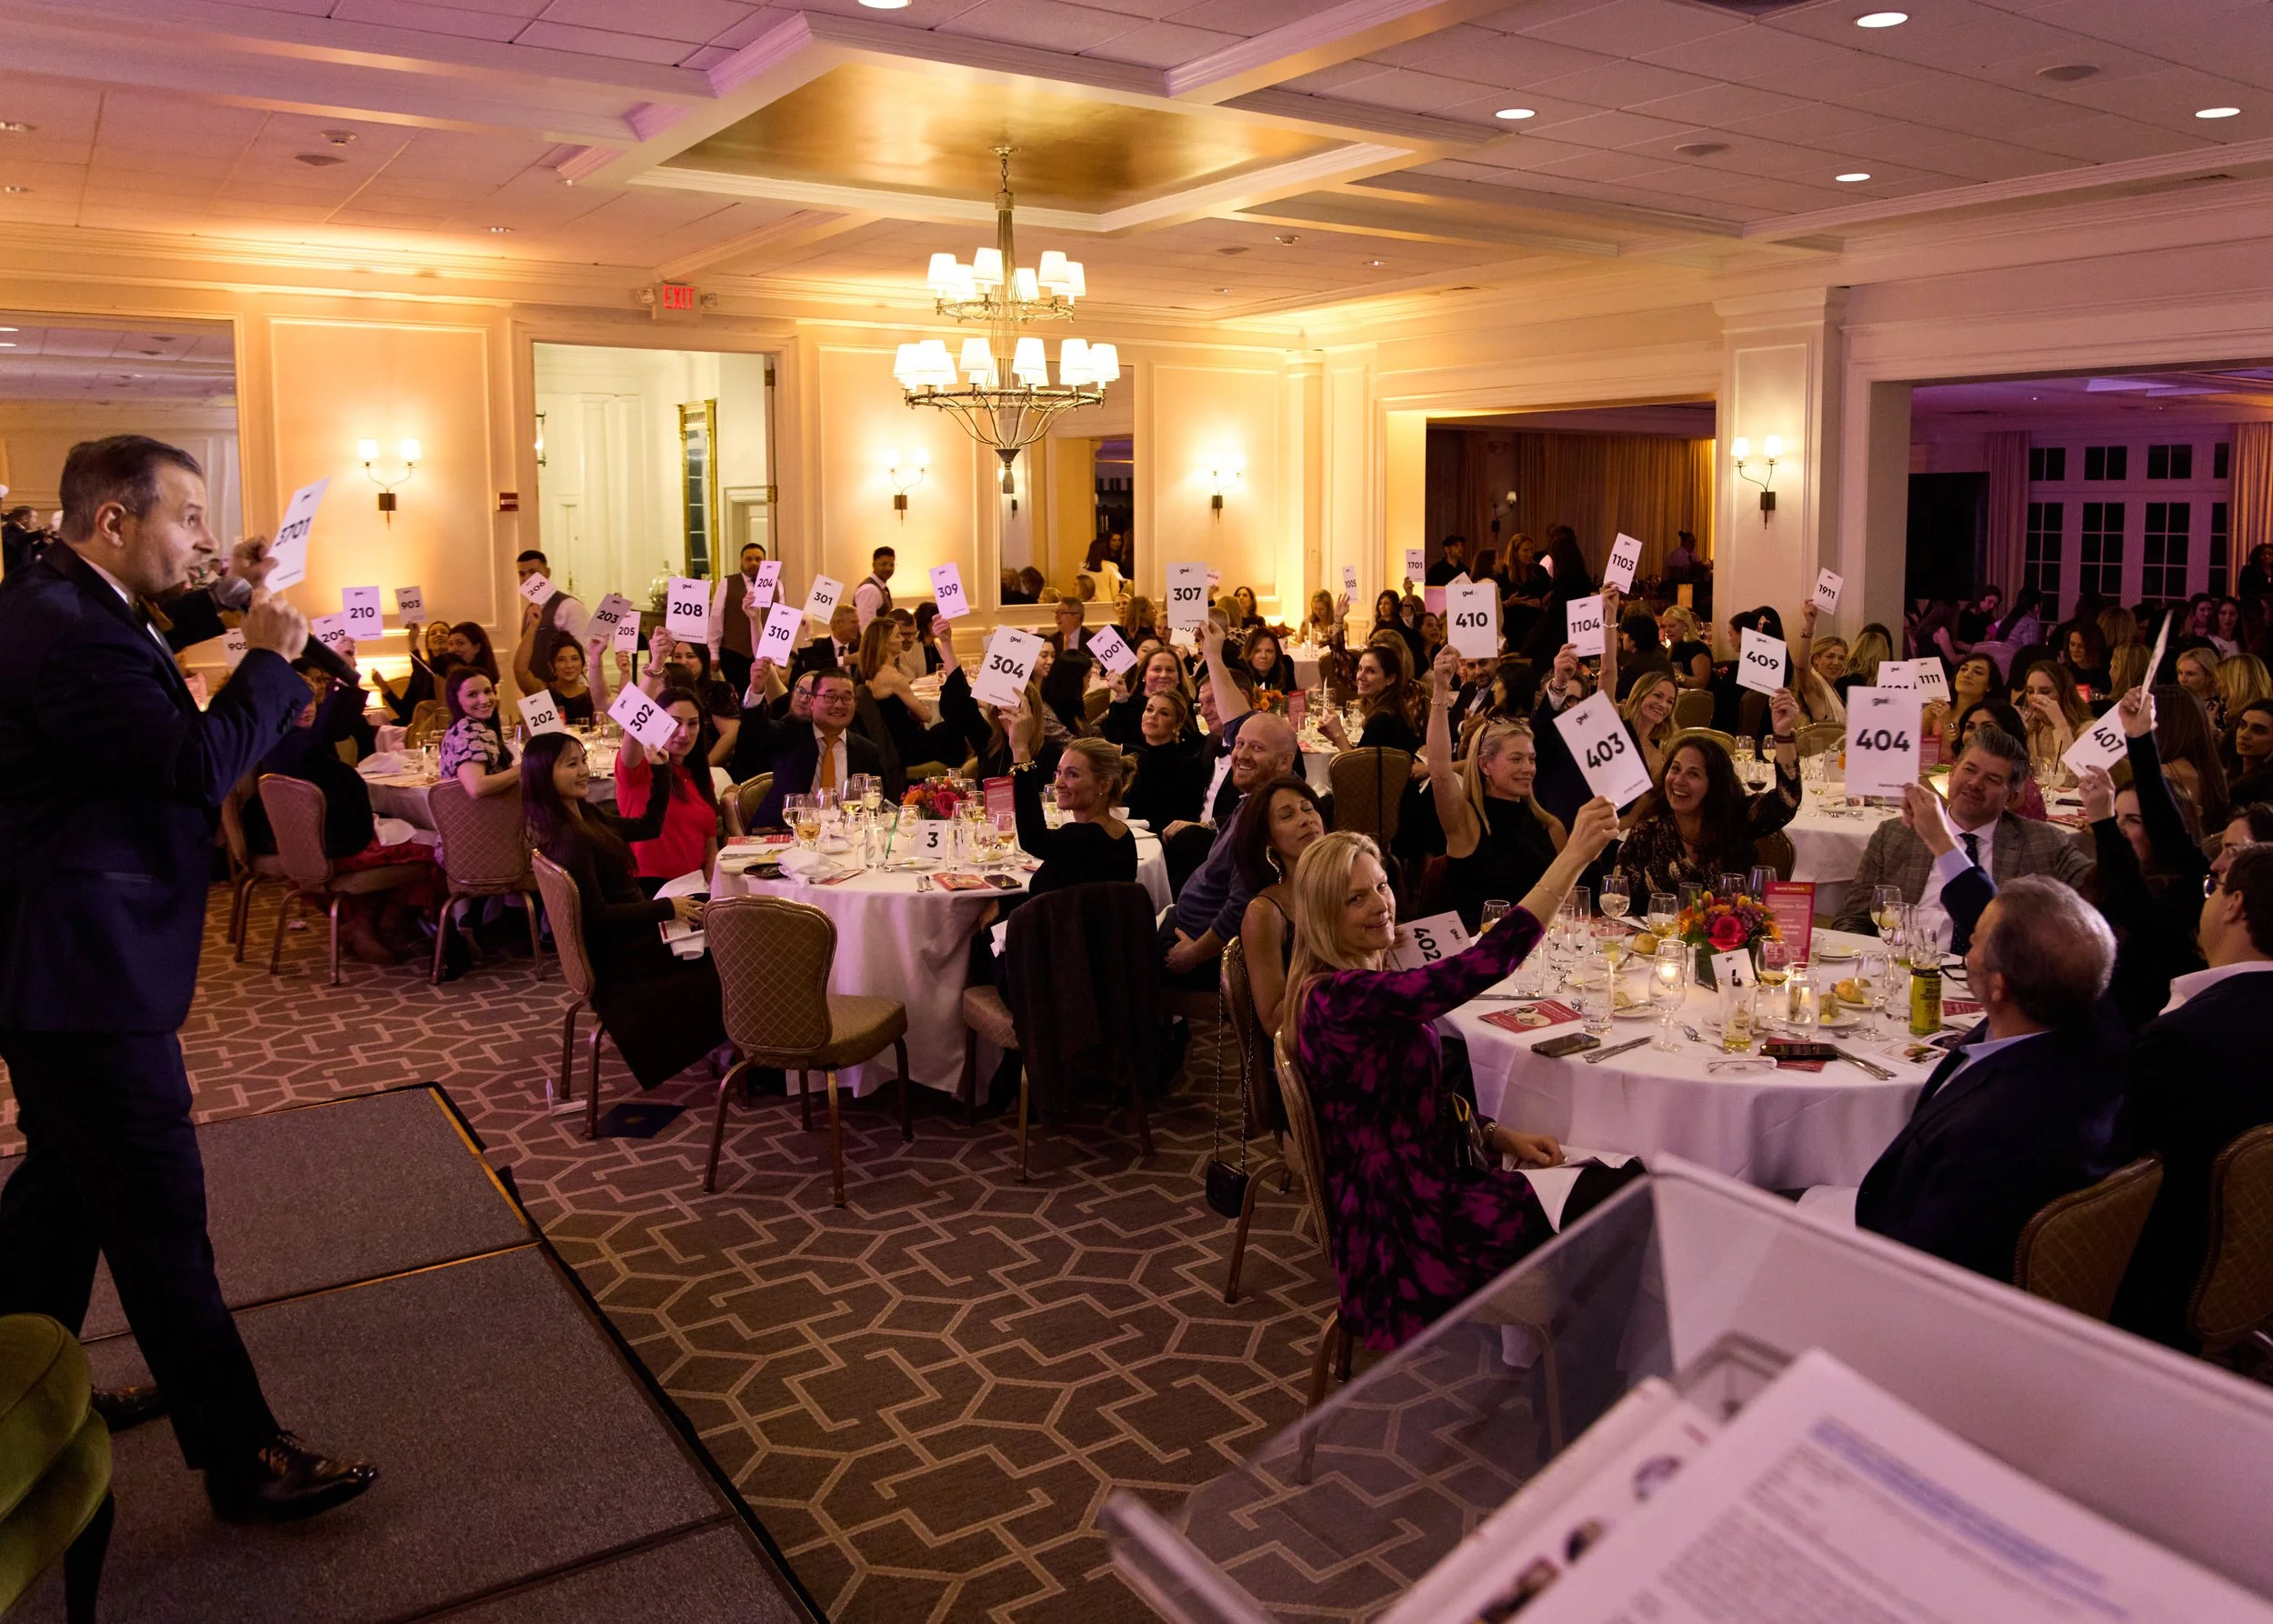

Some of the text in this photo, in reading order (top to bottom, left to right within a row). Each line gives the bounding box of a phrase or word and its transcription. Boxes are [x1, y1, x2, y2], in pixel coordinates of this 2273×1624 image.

[663, 285, 696, 310] EXIT
[1407, 561, 1423, 569] 1701
[1612, 554, 1635, 572] 1103
[527, 581, 546, 596] 206
[757, 578, 773, 587] 204
[937, 583, 958, 598] 309
[814, 591, 834, 606] 301
[1173, 586, 1202, 602] 307
[1818, 584, 1836, 599] 1911
[350, 606, 375, 619] 210
[401, 600, 421, 610] 903
[672, 601, 703, 617] 208
[596, 609, 620, 624] 203
[1455, 611, 1488, 628] 410
[617, 626, 636, 637] 205
[767, 625, 790, 641] 310
[1570, 617, 1601, 634] 1104
[1100, 640, 1125, 662] 1001
[989, 654, 1024, 679] 304
[1746, 650, 1779, 670] 409
[1918, 674, 1941, 685] 1111
[530, 710, 555, 727] 202
[630, 704, 655, 732] 302
[1856, 728, 1910, 752] 404
[2093, 727, 2124, 753] 407
[1586, 731, 1625, 769] 403
[926, 831, 939, 848] 3
[1414, 927, 1442, 961] 402
